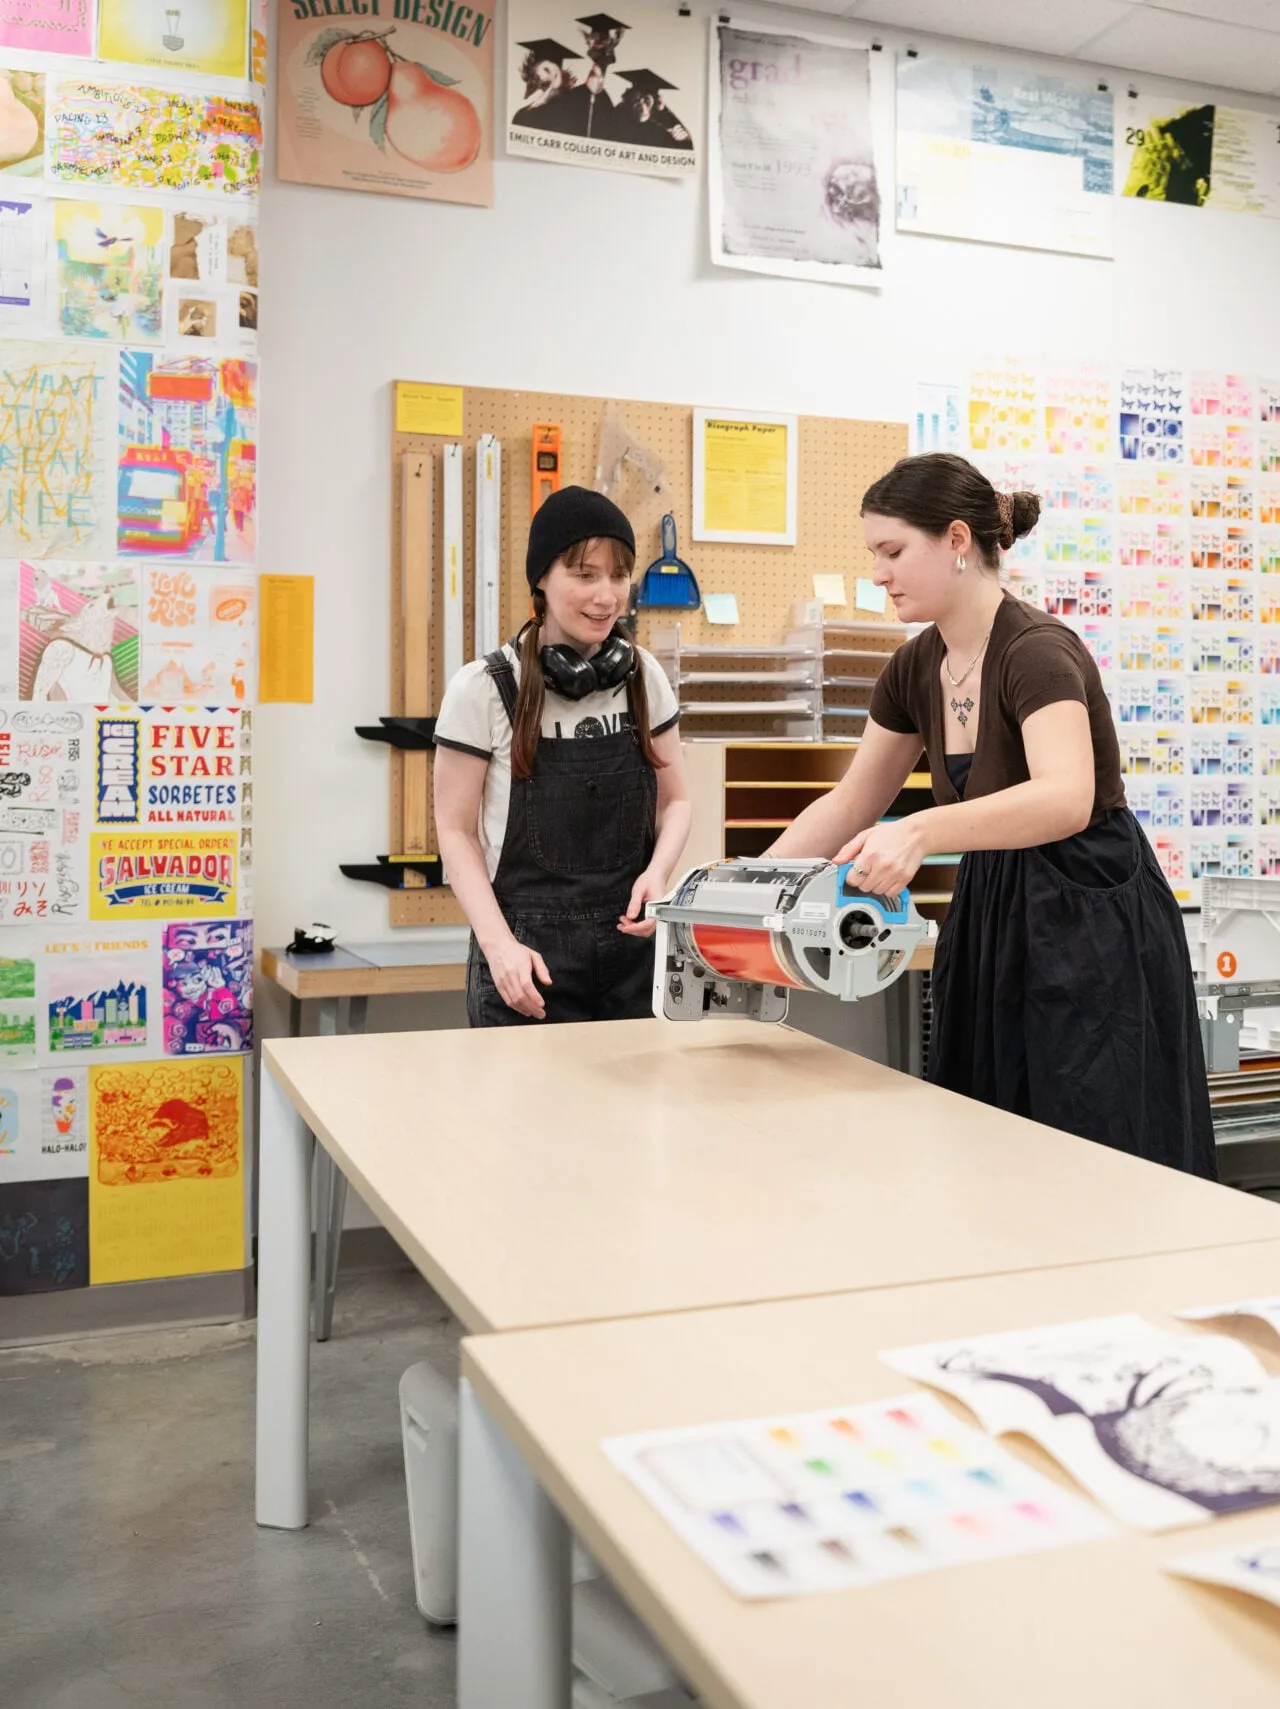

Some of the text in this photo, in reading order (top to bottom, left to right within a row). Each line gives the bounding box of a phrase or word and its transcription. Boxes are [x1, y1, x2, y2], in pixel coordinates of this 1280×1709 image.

[394, 0, 491, 47] DESIGN
[728, 54, 804, 91] grad
[1125, 127, 1145, 146] 29
[509, 132, 695, 166] EMILY CARR COLLEGE OF ART AND DESIGN
[101, 724, 135, 738] ICE
[151, 725, 235, 748] FIVE
[151, 755, 235, 777] STAR
[148, 785, 236, 805] SORBETES
[148, 810, 235, 822] ALL NATURAL
[118, 840, 153, 850] ACCEPT
[158, 839, 195, 850] SPECIAL
[100, 854, 234, 891] SALVADOR
[144, 884, 190, 895] ICE CREAM
[44, 940, 148, 954] LET'S FRIENDS
[1222, 956, 1231, 972] 1
[41, 1142, 87, 1154] HALO-HALO!
